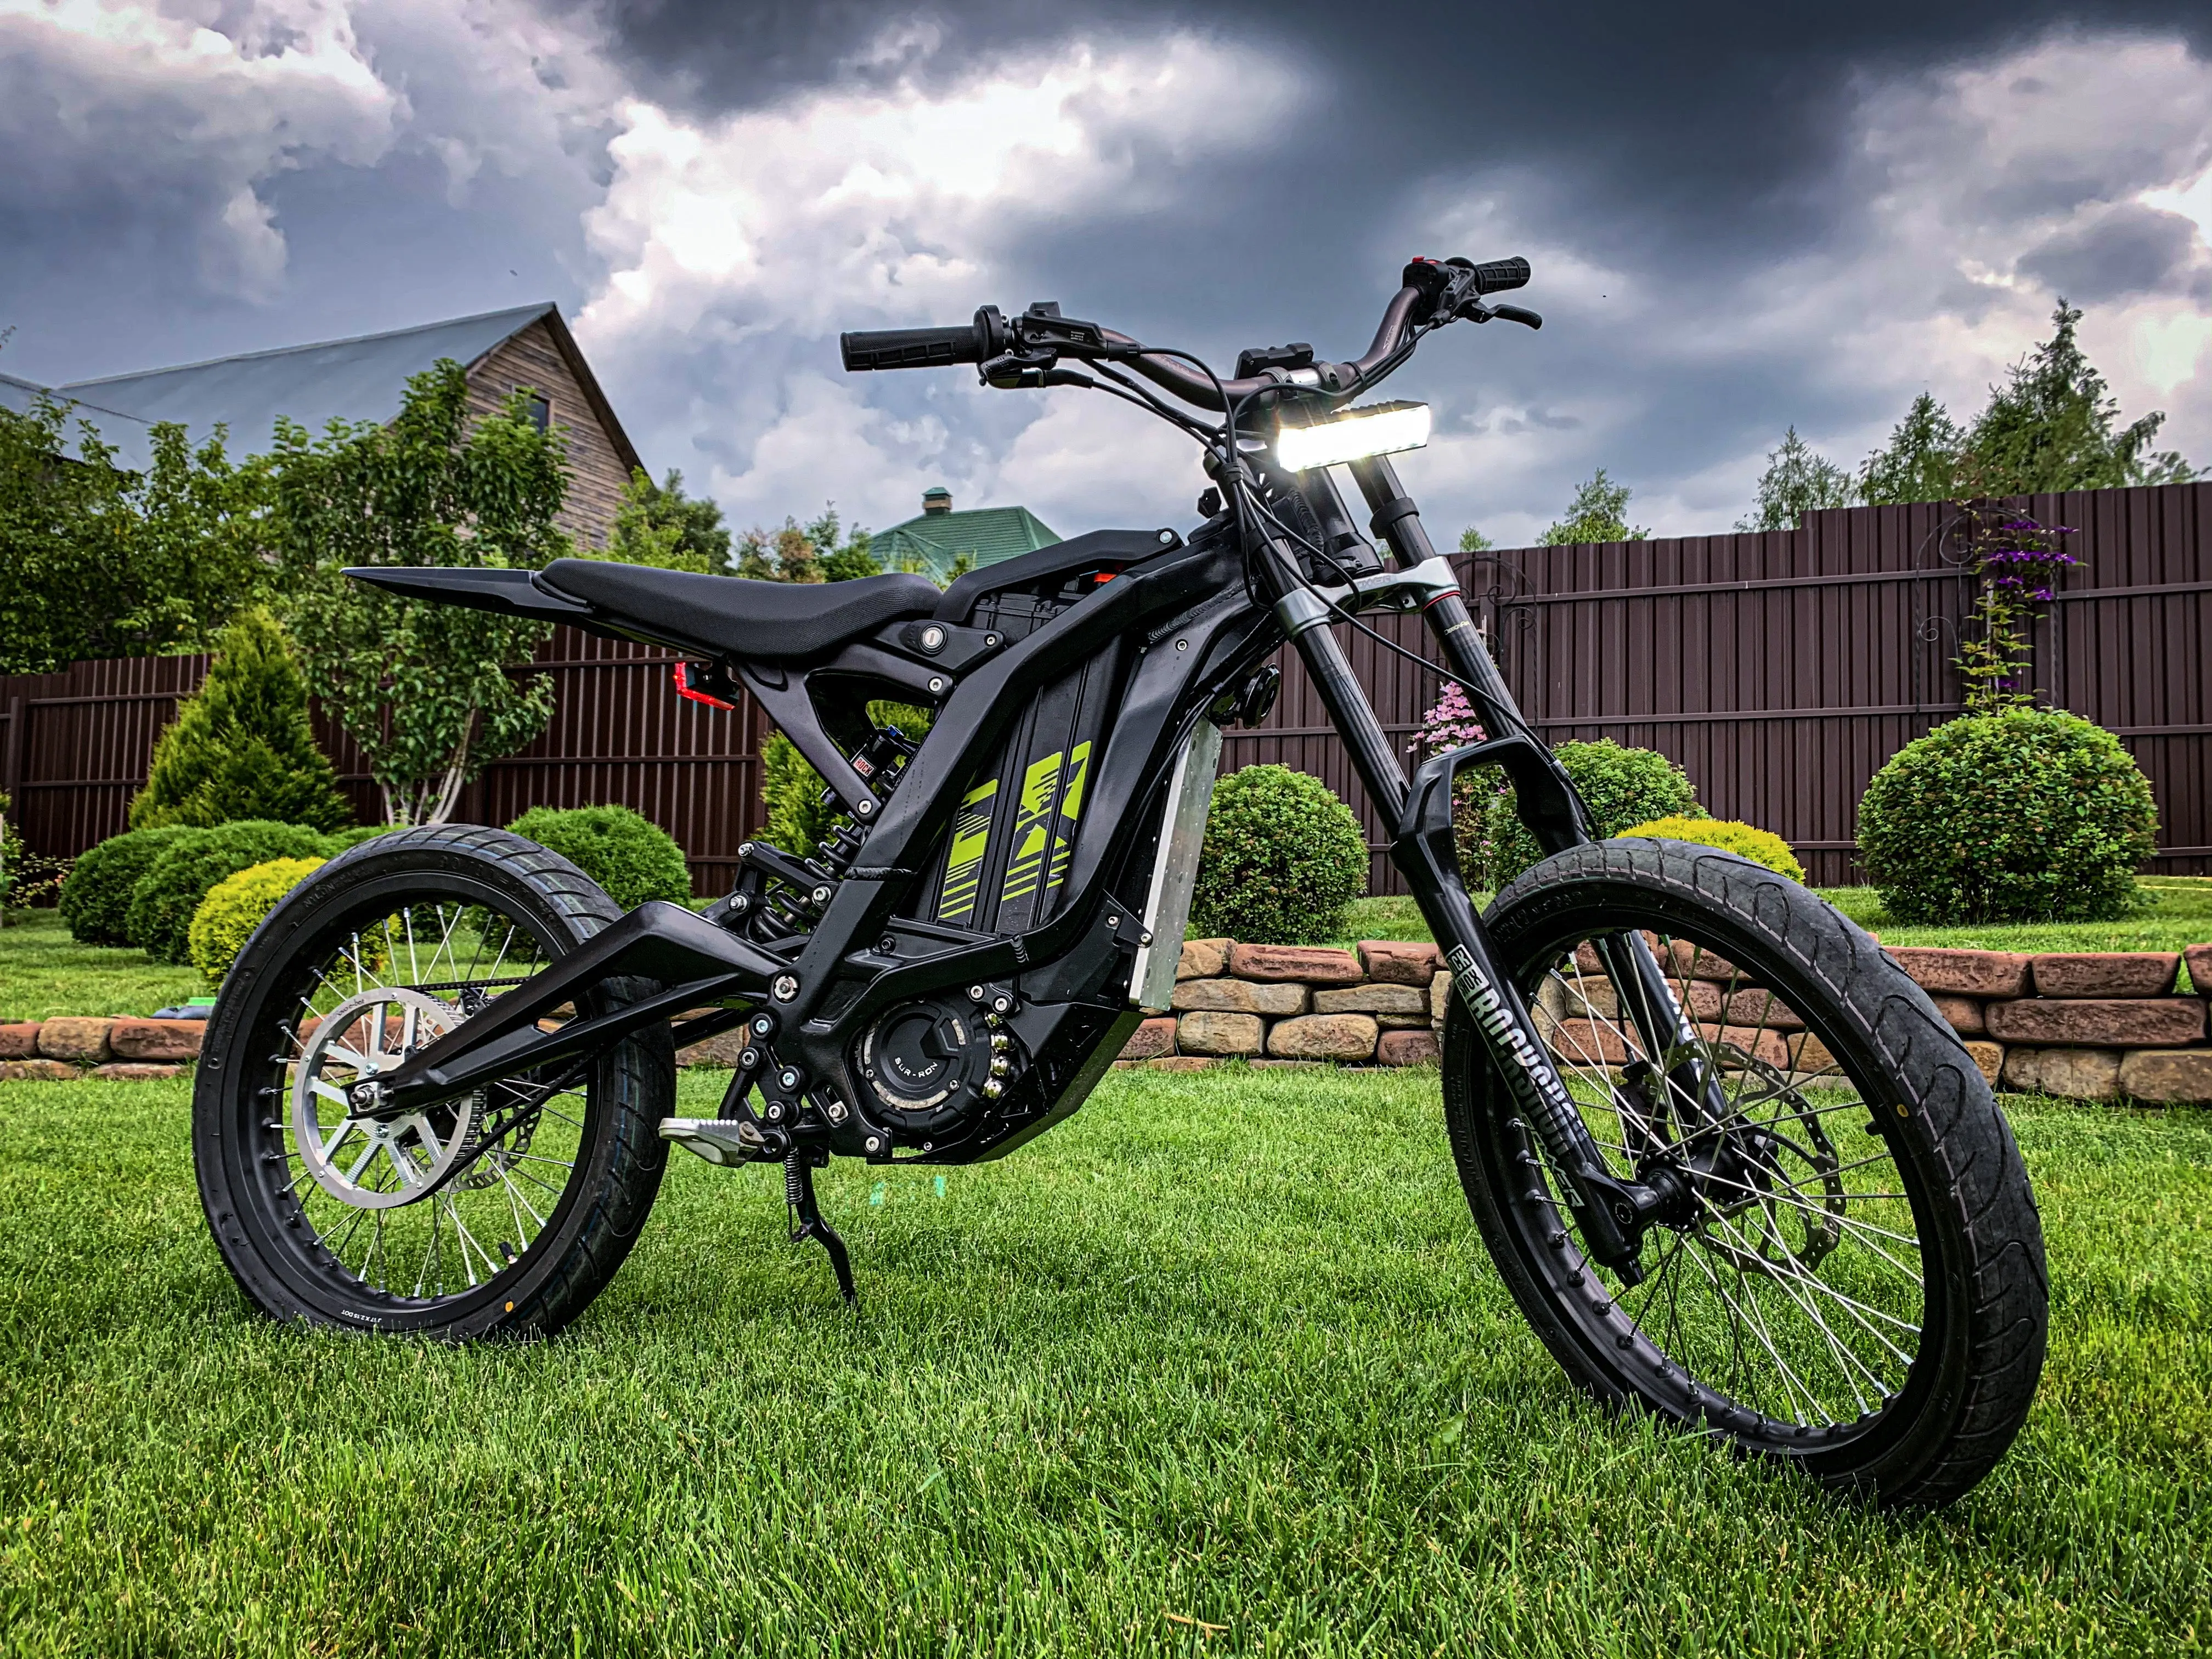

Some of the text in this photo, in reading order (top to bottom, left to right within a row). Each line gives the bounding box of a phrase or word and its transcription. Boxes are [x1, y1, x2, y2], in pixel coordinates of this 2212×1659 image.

[855, 758, 873, 775] ROCK
[1447, 950, 1471, 975] OCK
[895, 1057, 938, 1078] SUR-RON
